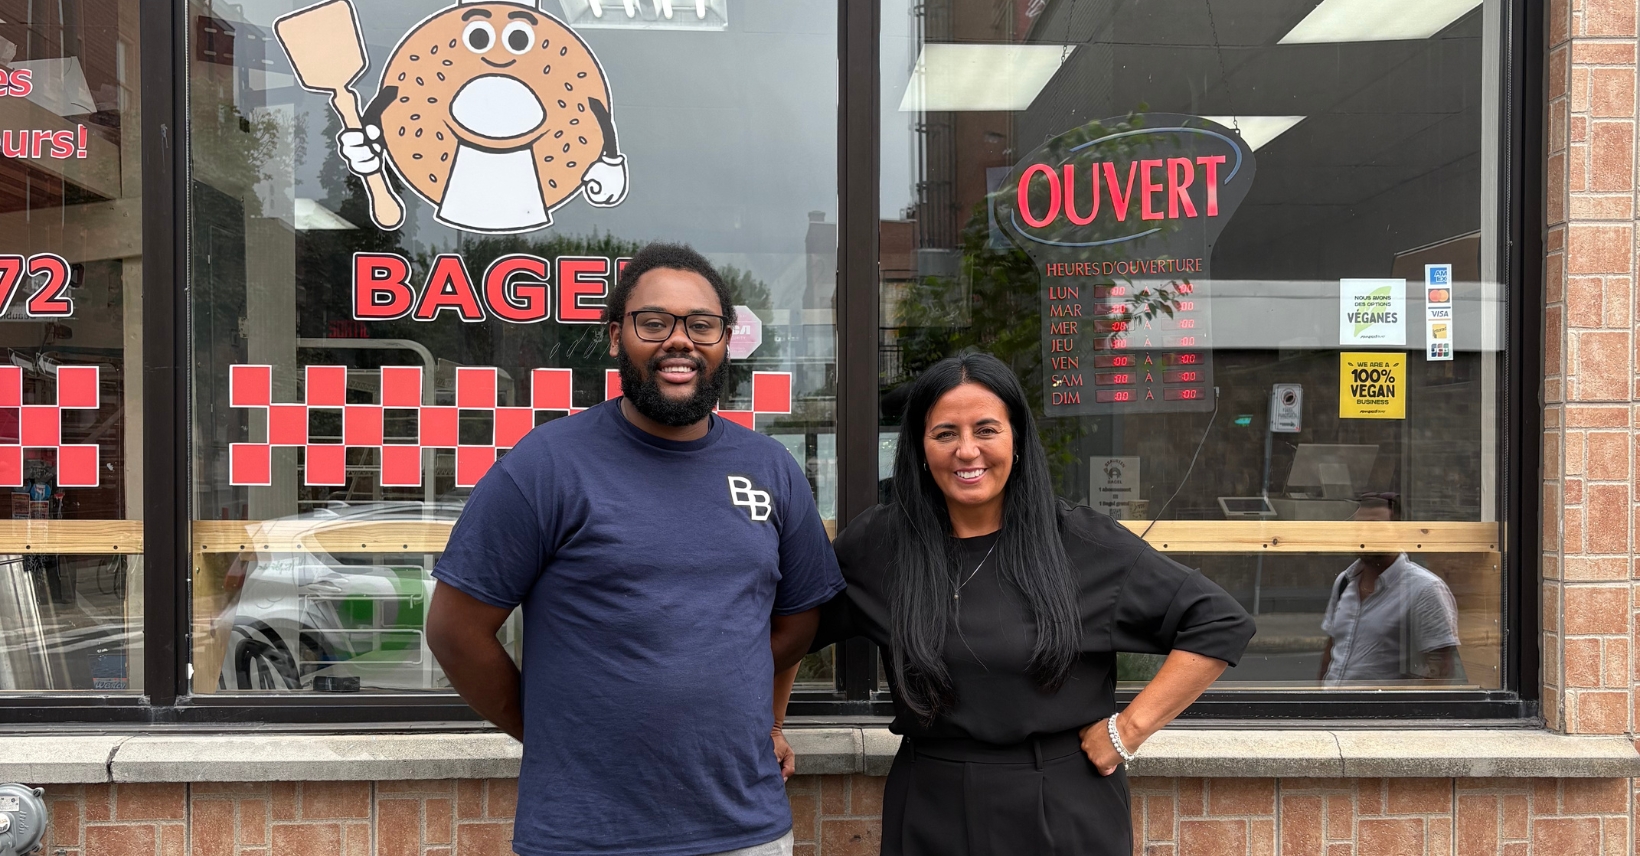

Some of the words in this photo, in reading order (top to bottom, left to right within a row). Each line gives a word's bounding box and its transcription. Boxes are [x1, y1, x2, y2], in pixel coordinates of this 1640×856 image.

[0, 123, 88, 159] urs!
[1017, 155, 1226, 228] OUVERT
[1046, 262, 1100, 277] HEURES
[1102, 258, 1203, 275] D'OUVERTURE
[352, 252, 633, 324] BAGE
[1049, 287, 1079, 300] LUN
[1050, 304, 1082, 317] MAR
[1347, 309, 1398, 323] VÉGANES
[1050, 321, 1078, 335] MER
[1051, 339, 1073, 353] JEU
[1051, 356, 1079, 370] VEN
[1051, 374, 1083, 387] SAM
[1351, 369, 1396, 383] 100%
[1350, 384, 1395, 398] VEGAN
[1052, 391, 1081, 406] DIM
[727, 475, 772, 520] BB
